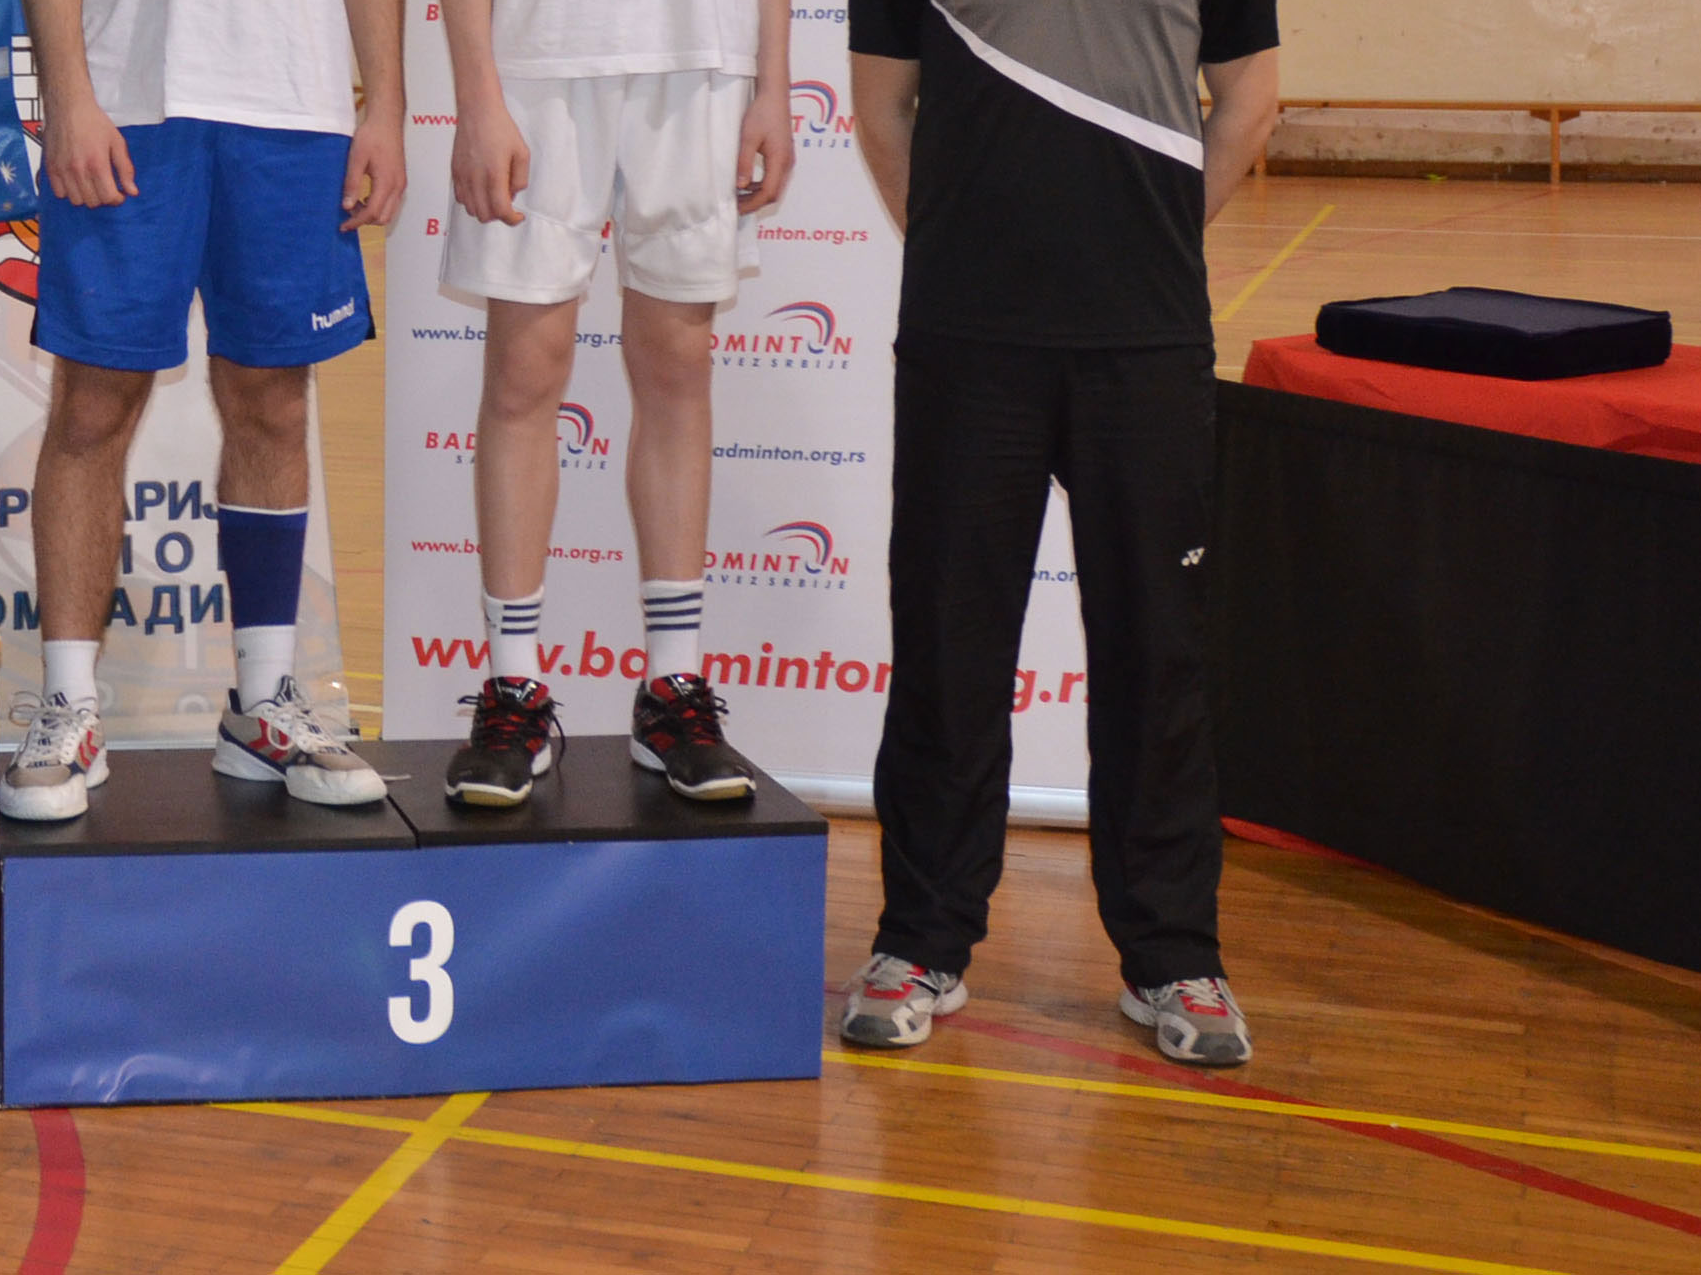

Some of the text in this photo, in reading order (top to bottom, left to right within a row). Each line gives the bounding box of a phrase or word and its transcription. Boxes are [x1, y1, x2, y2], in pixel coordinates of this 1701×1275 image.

[771, 357, 851, 370] SRBIJE
[712, 442, 867, 465] adminton.org.rs
[705, 573, 846, 590] AVEZ SRBIJE
[387, 899, 455, 1044] 3
